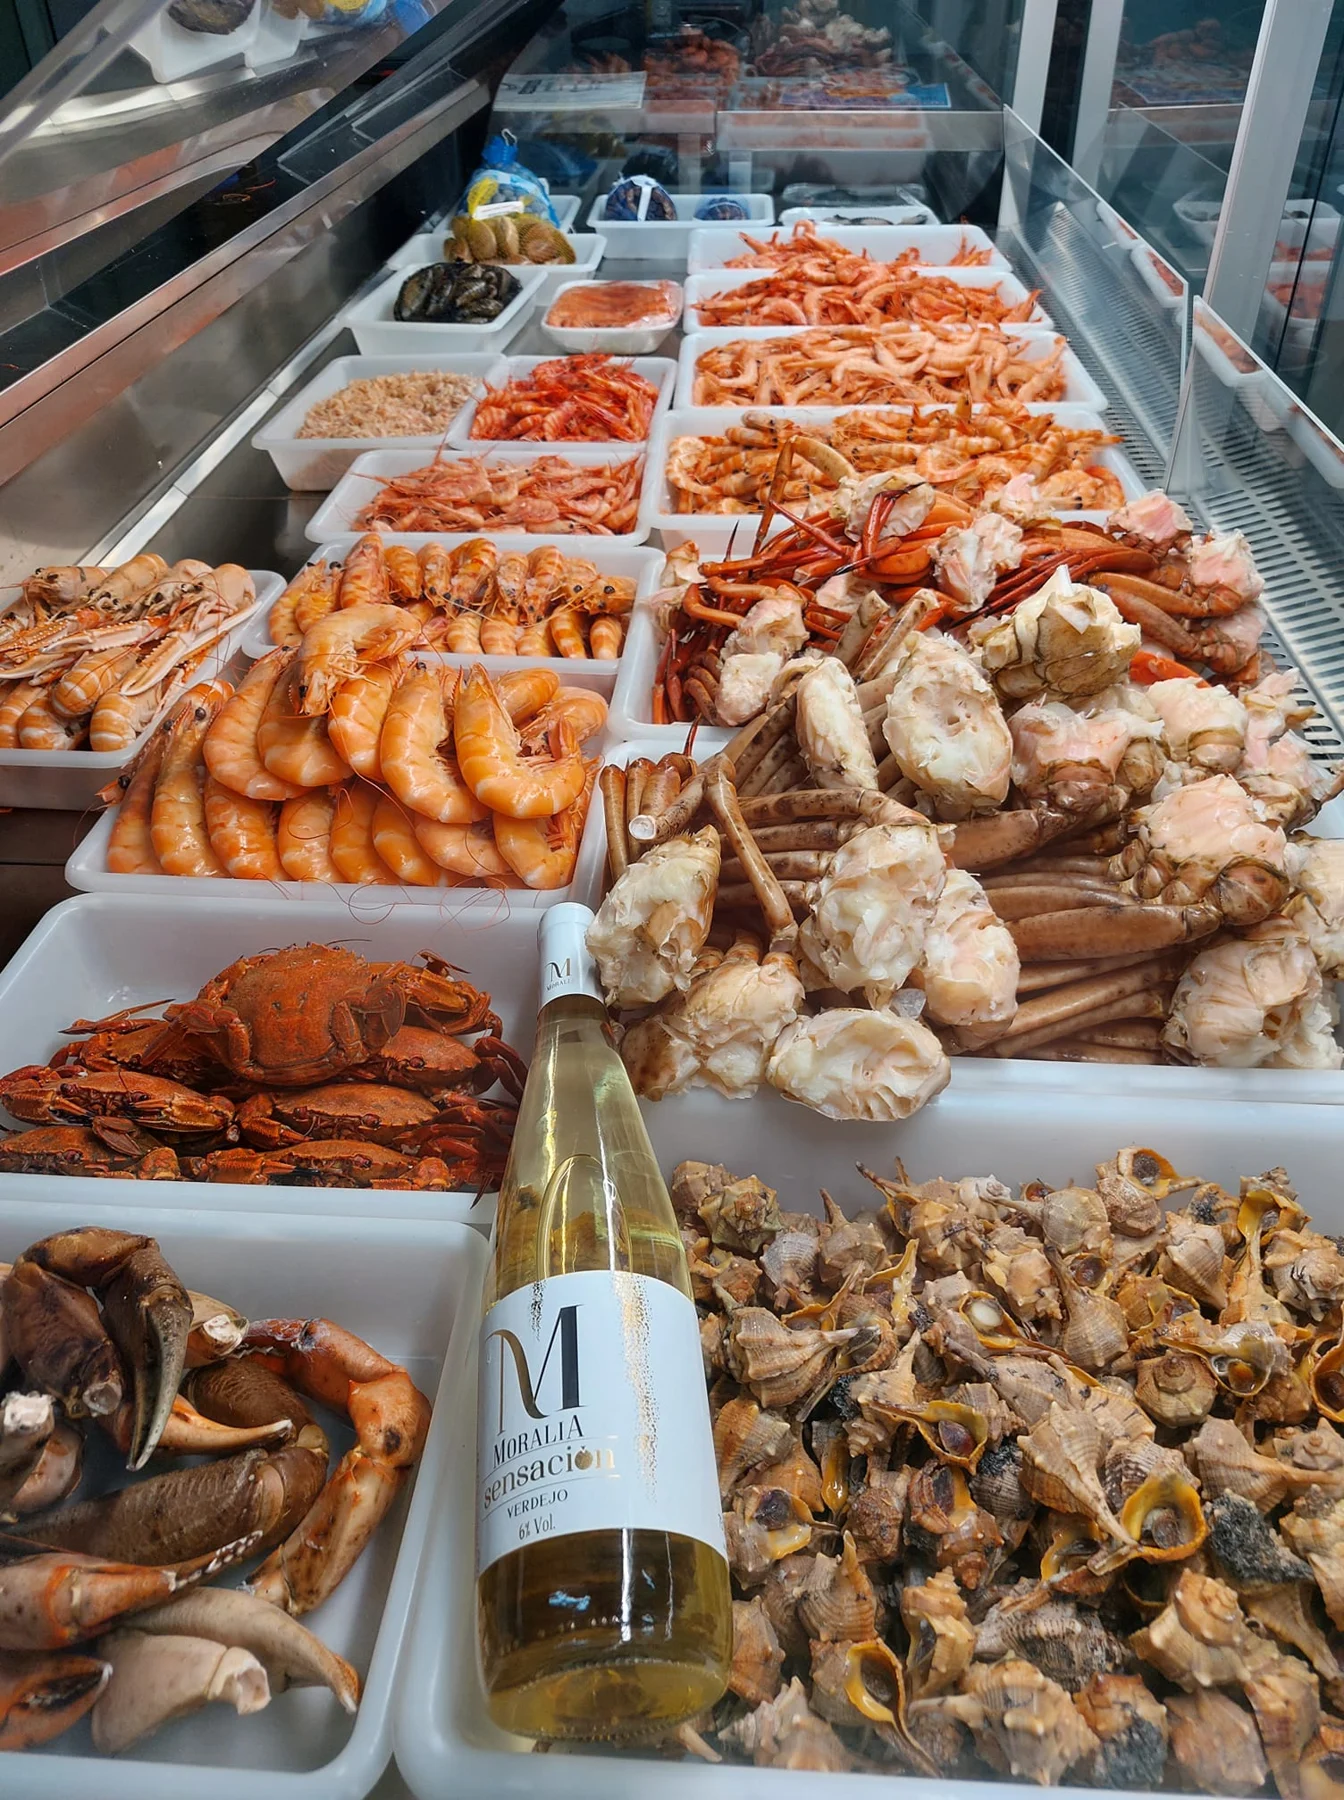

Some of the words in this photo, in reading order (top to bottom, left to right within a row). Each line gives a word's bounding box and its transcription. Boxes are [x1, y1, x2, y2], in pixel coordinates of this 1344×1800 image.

[545, 957, 571, 982] M
[485, 1304, 588, 1436] M
[493, 1414, 584, 1469] MORALIA
[507, 1489, 568, 1519] VERDEJO
[519, 1522, 531, 1540] 6%
